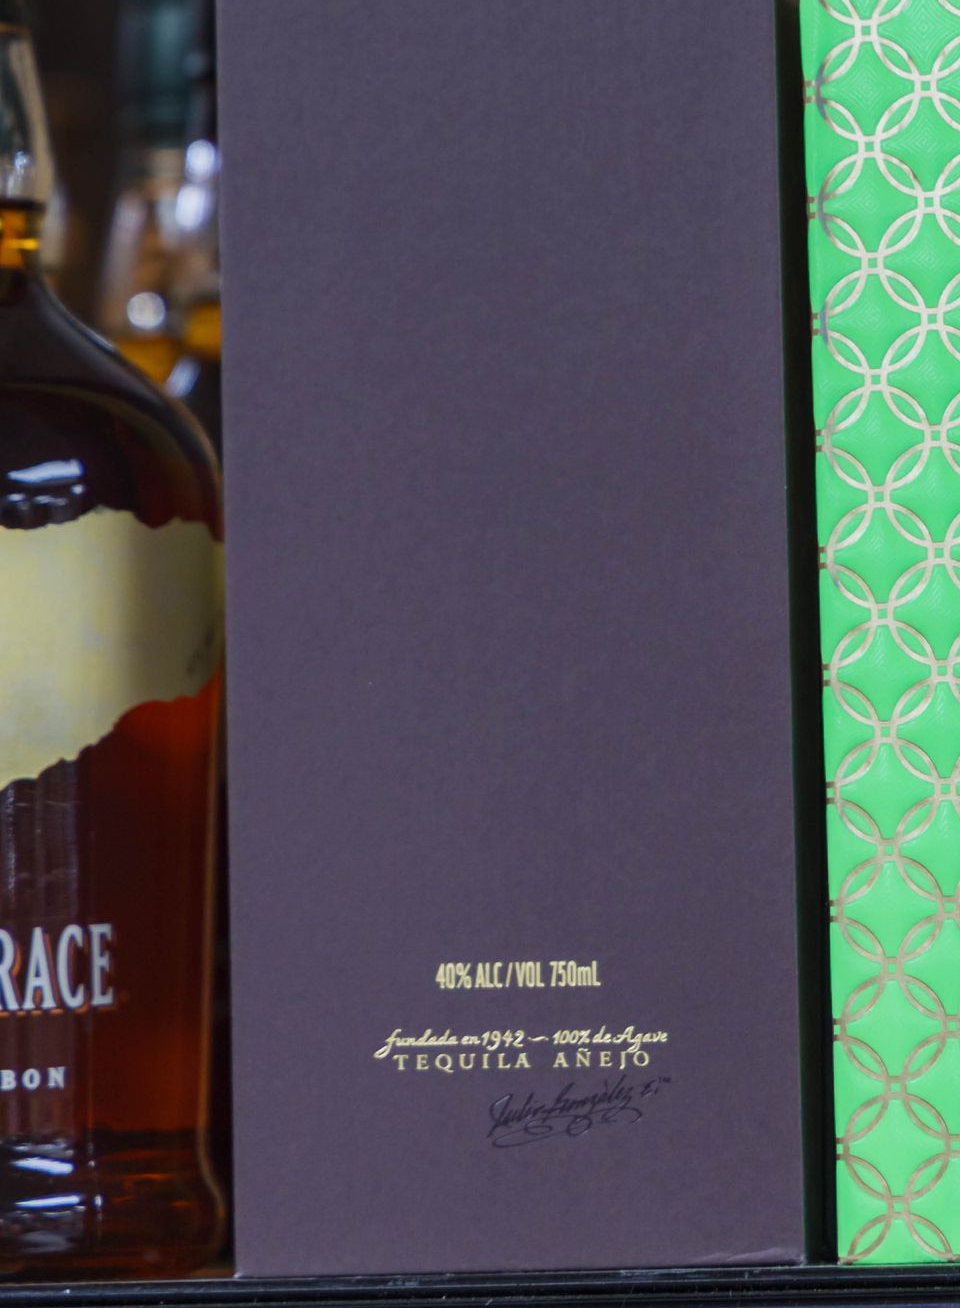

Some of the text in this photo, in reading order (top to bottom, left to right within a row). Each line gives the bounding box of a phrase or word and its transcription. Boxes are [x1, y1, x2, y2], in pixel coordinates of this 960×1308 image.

[435, 962, 473, 990] 40%
[549, 960, 602, 988] 750mL
[373, 1028, 460, 1059] fundada
[481, 1029, 525, 1051] 1942
[552, 1029, 591, 1046] 100%
[591, 1025, 612, 1044] de
[612, 1025, 669, 1052] Agave
[392, 1047, 650, 1073] TEQUILA AÑEJO
